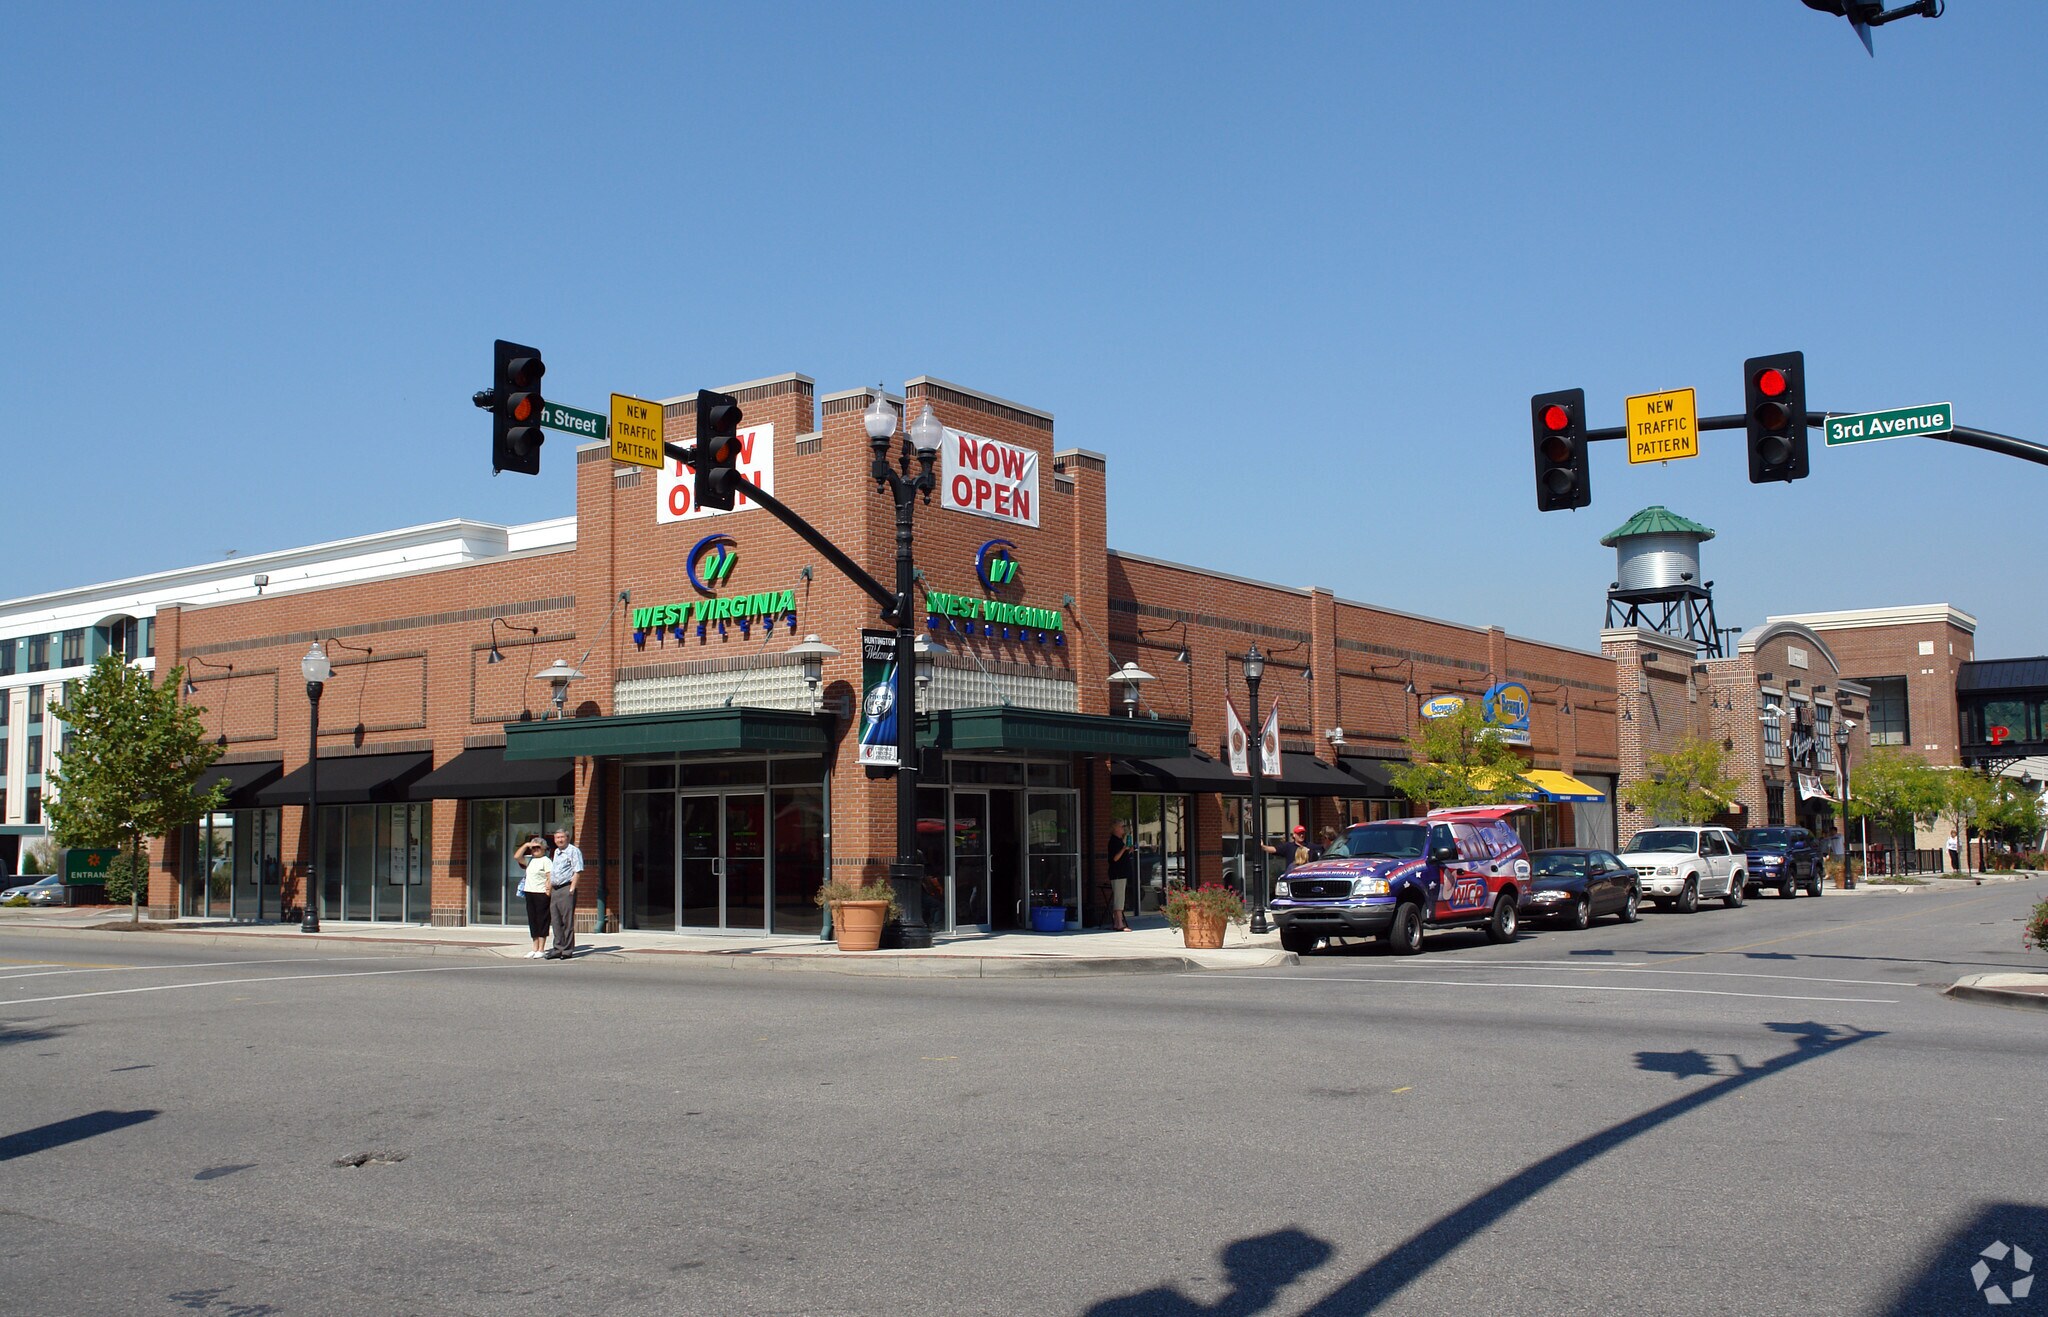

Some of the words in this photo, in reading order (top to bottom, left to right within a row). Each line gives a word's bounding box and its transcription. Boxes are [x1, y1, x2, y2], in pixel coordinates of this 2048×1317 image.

[626, 404, 648, 420] NEW
[1647, 399, 1674, 415] NEW
[554, 409, 597, 434] Street
[617, 422, 657, 442] TRAFFIC
[1637, 417, 1687, 436] TRAFFIC
[1832, 420, 1864, 440] 3rd
[1868, 413, 1945, 435] Avenue
[616, 441, 658, 461] PATTERN
[1636, 436, 1690, 456] PATTERN
[958, 435, 1025, 481] NOW
[952, 474, 1030, 521] OPEN
[633, 602, 693, 629] WEST
[694, 589, 797, 622] VIRGINIA
[926, 590, 982, 619] WEST
[982, 600, 1064, 631] VIRGINIA
[633, 614, 797, 645] WIRELESS
[863, 635, 896, 647] HUNTINGTON
[864, 644, 895, 661] Welcome
[1452, 879, 1485, 908] WTCR
